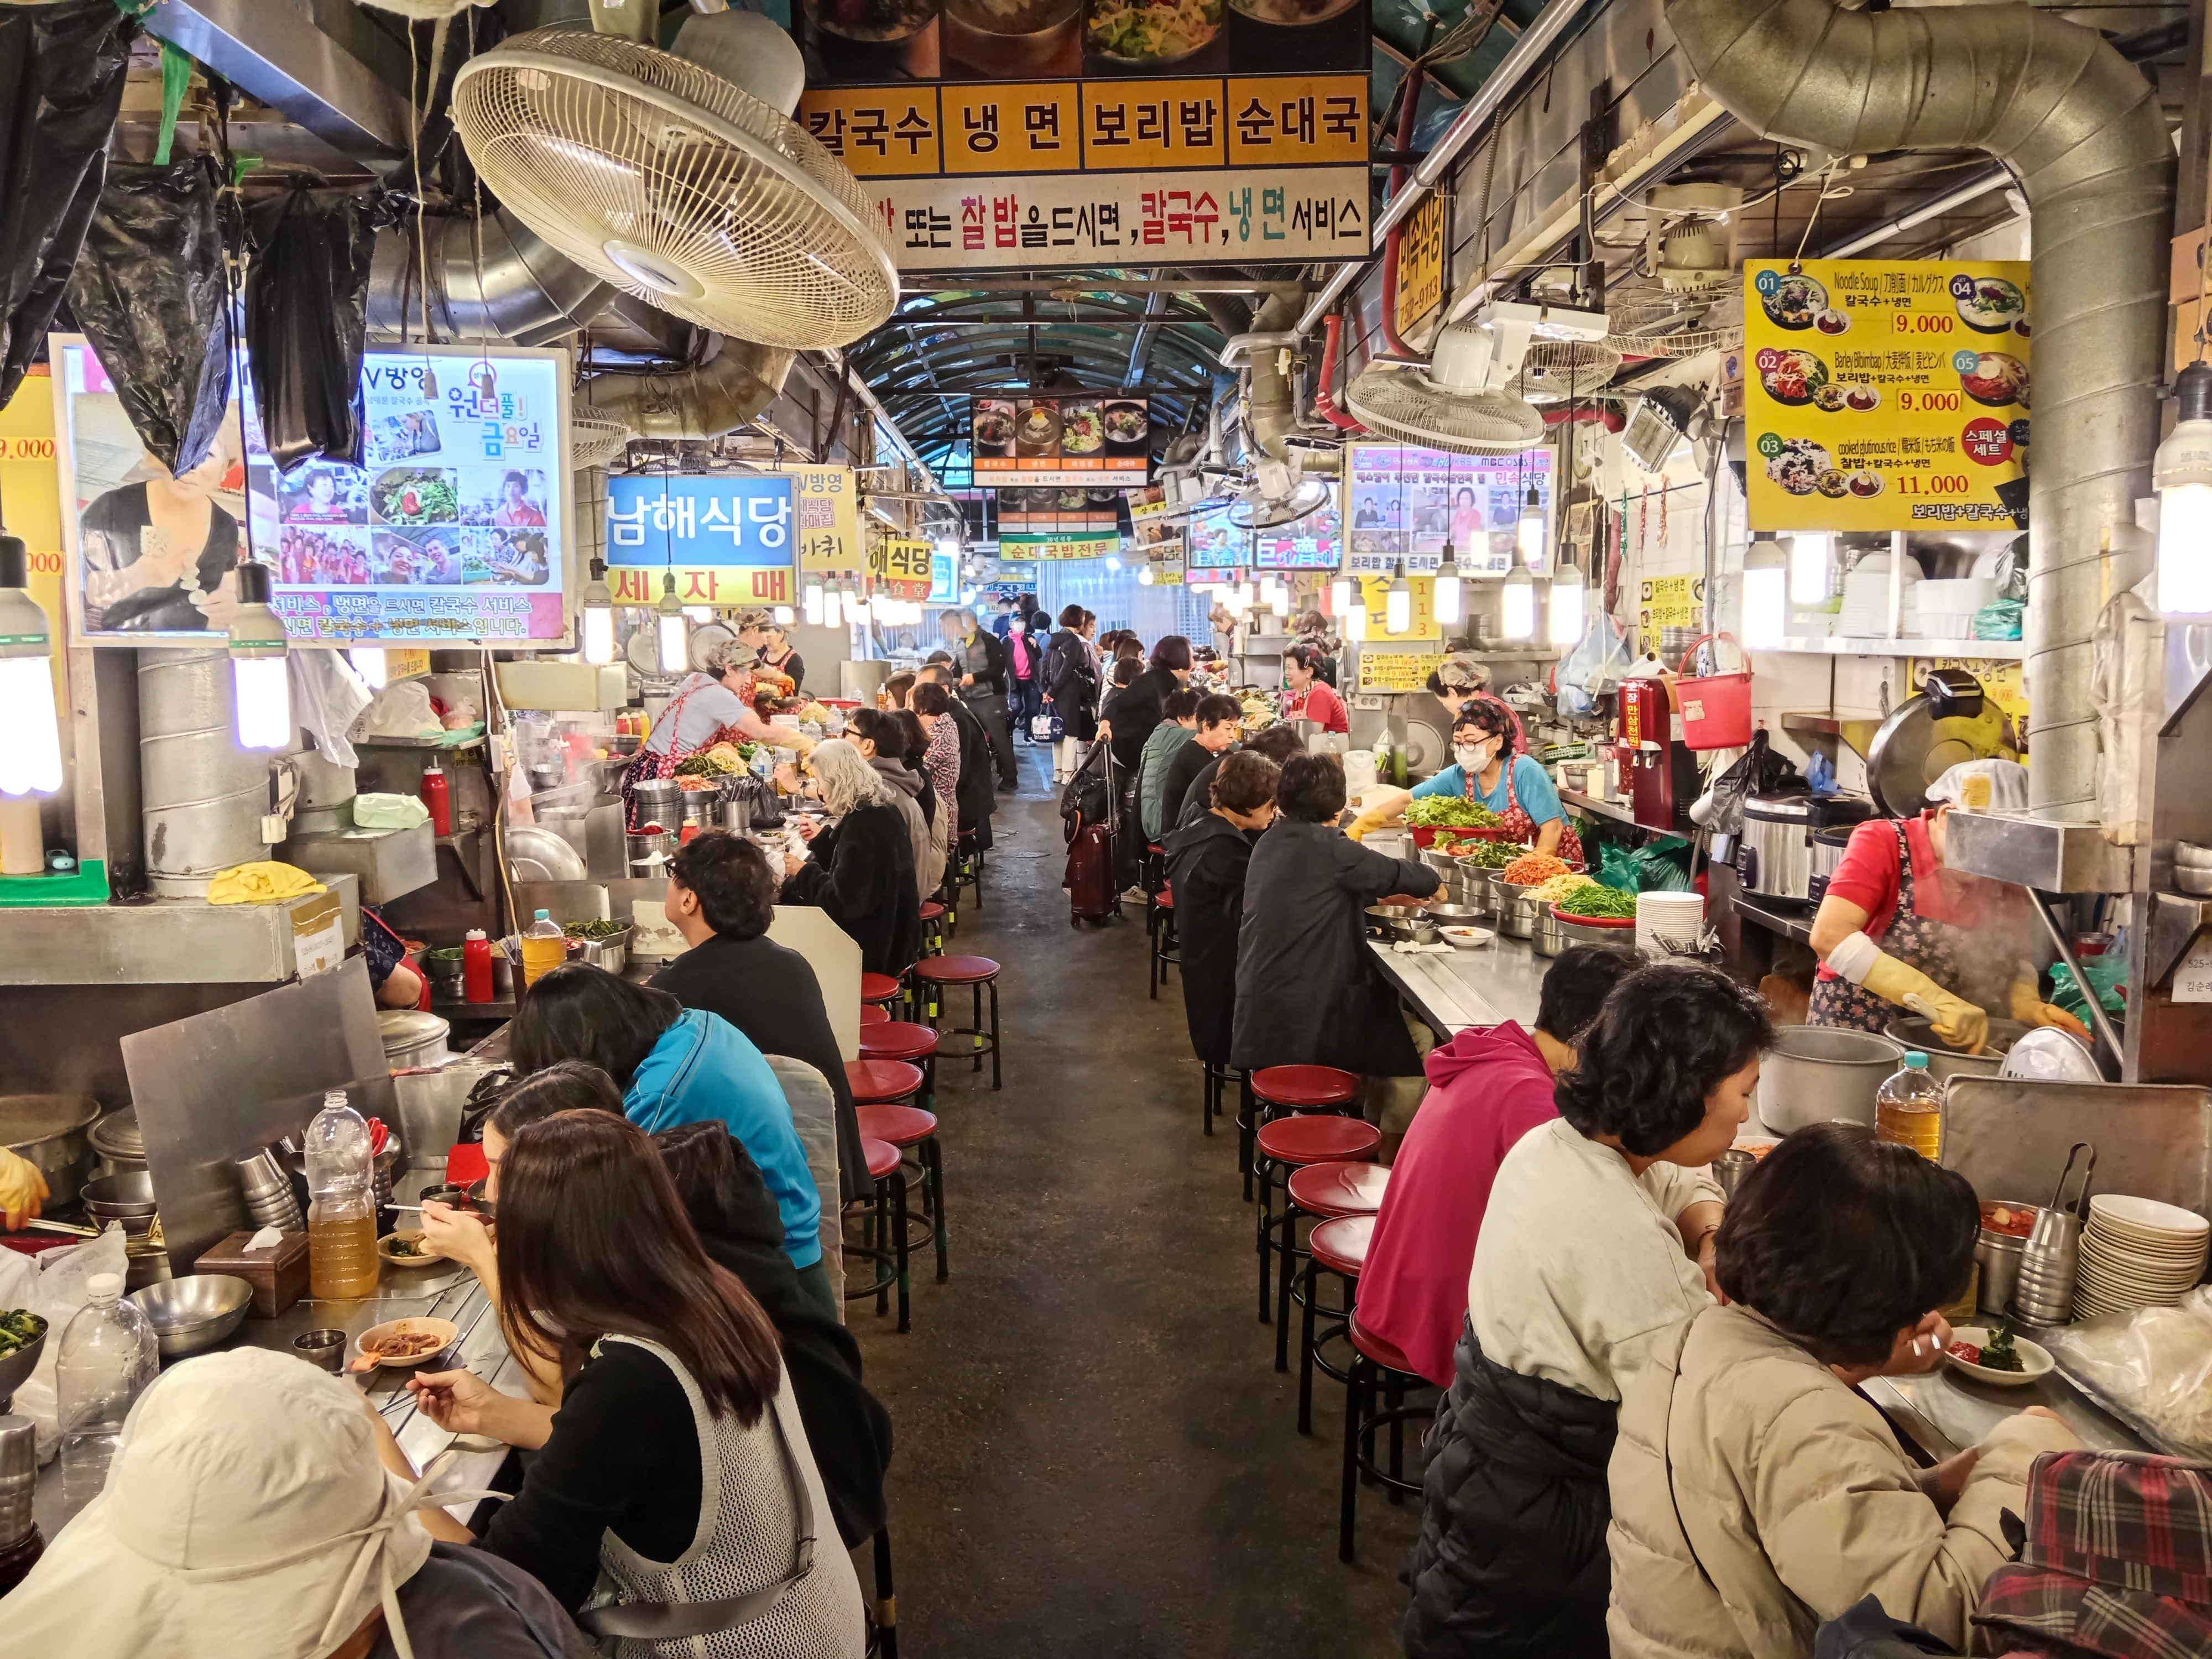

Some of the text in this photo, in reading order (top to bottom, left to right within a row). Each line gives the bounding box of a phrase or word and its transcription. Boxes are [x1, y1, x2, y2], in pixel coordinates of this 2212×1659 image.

[1092, 99, 1217, 148] 보리밥
[1236, 96, 1361, 145] 순대국
[809, 107, 932, 156] 칼국수
[906, 206, 951, 248] 또는
[1293, 197, 1361, 241] 서비스
[1758, 278, 1775, 290] 01
[1834, 272, 1859, 289] Noodle
[1860, 272, 1878, 294] Soup
[1953, 283, 1970, 295] 04
[1399, 275, 1438, 327] 752-9113
[1896, 315, 1953, 333] 9.000
[1759, 357, 1776, 369] 02
[1835, 352, 1853, 372] Barley
[1957, 358, 1974, 369] 05
[1901, 393, 1958, 411] 9.000
[1965, 430, 2007, 444] 스페셜
[1761, 441, 1778, 452] 03
[1838, 440, 1859, 455] cooked
[1973, 444, 2001, 456] 세트
[1454, 457, 1472, 466] KBS
[1481, 458, 1504, 466] MBC
[1496, 472, 1546, 486] 민속식당
[1897, 476, 1968, 495] 11.000
[608, 495, 792, 547] 남해식당
[1351, 557, 1381, 569] 보리밥
[333, 596, 382, 614] 냉면을
[385, 599, 425, 613] 드시면
[429, 597, 478, 614] 칼국수
[482, 597, 531, 614] 서비스
[1627, 705, 1639, 747] 만삼천원
